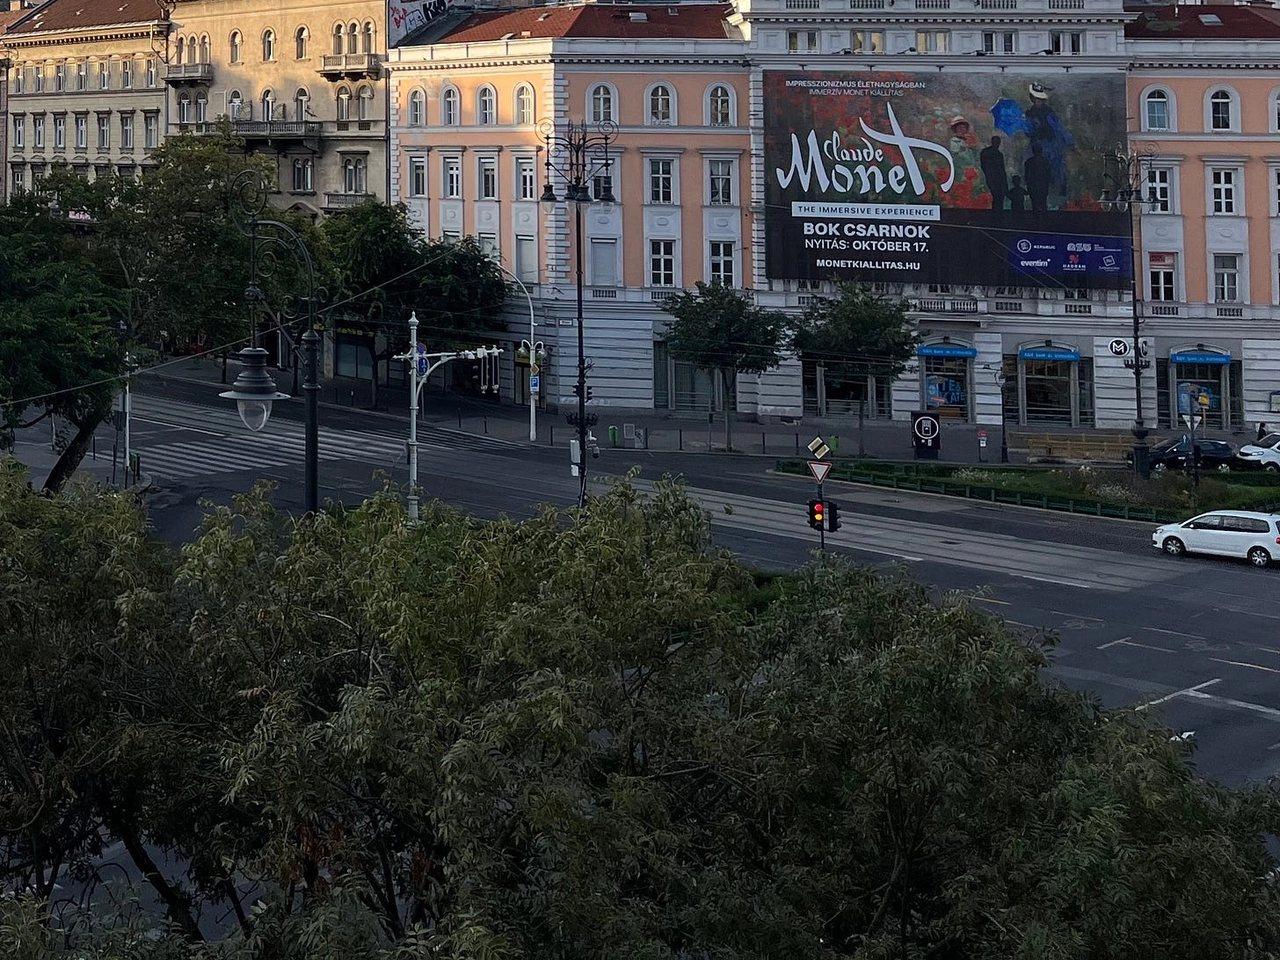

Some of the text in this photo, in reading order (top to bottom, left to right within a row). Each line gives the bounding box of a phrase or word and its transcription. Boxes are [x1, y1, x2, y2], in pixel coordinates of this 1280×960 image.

[785, 80, 857, 88] IMPRESSZIONIZMUS
[823, 131, 884, 162] Claude
[819, 206, 872, 215] IMMERSIVE
[875, 208, 935, 216] EXPERIENCE
[803, 222, 931, 239] BOK CSARNOK
[805, 238, 929, 253] NYITÁS: OKTÓBER 17.
[816, 259, 921, 270] MONETKIALLITAS.HU
[1020, 258, 1048, 267] eventim
